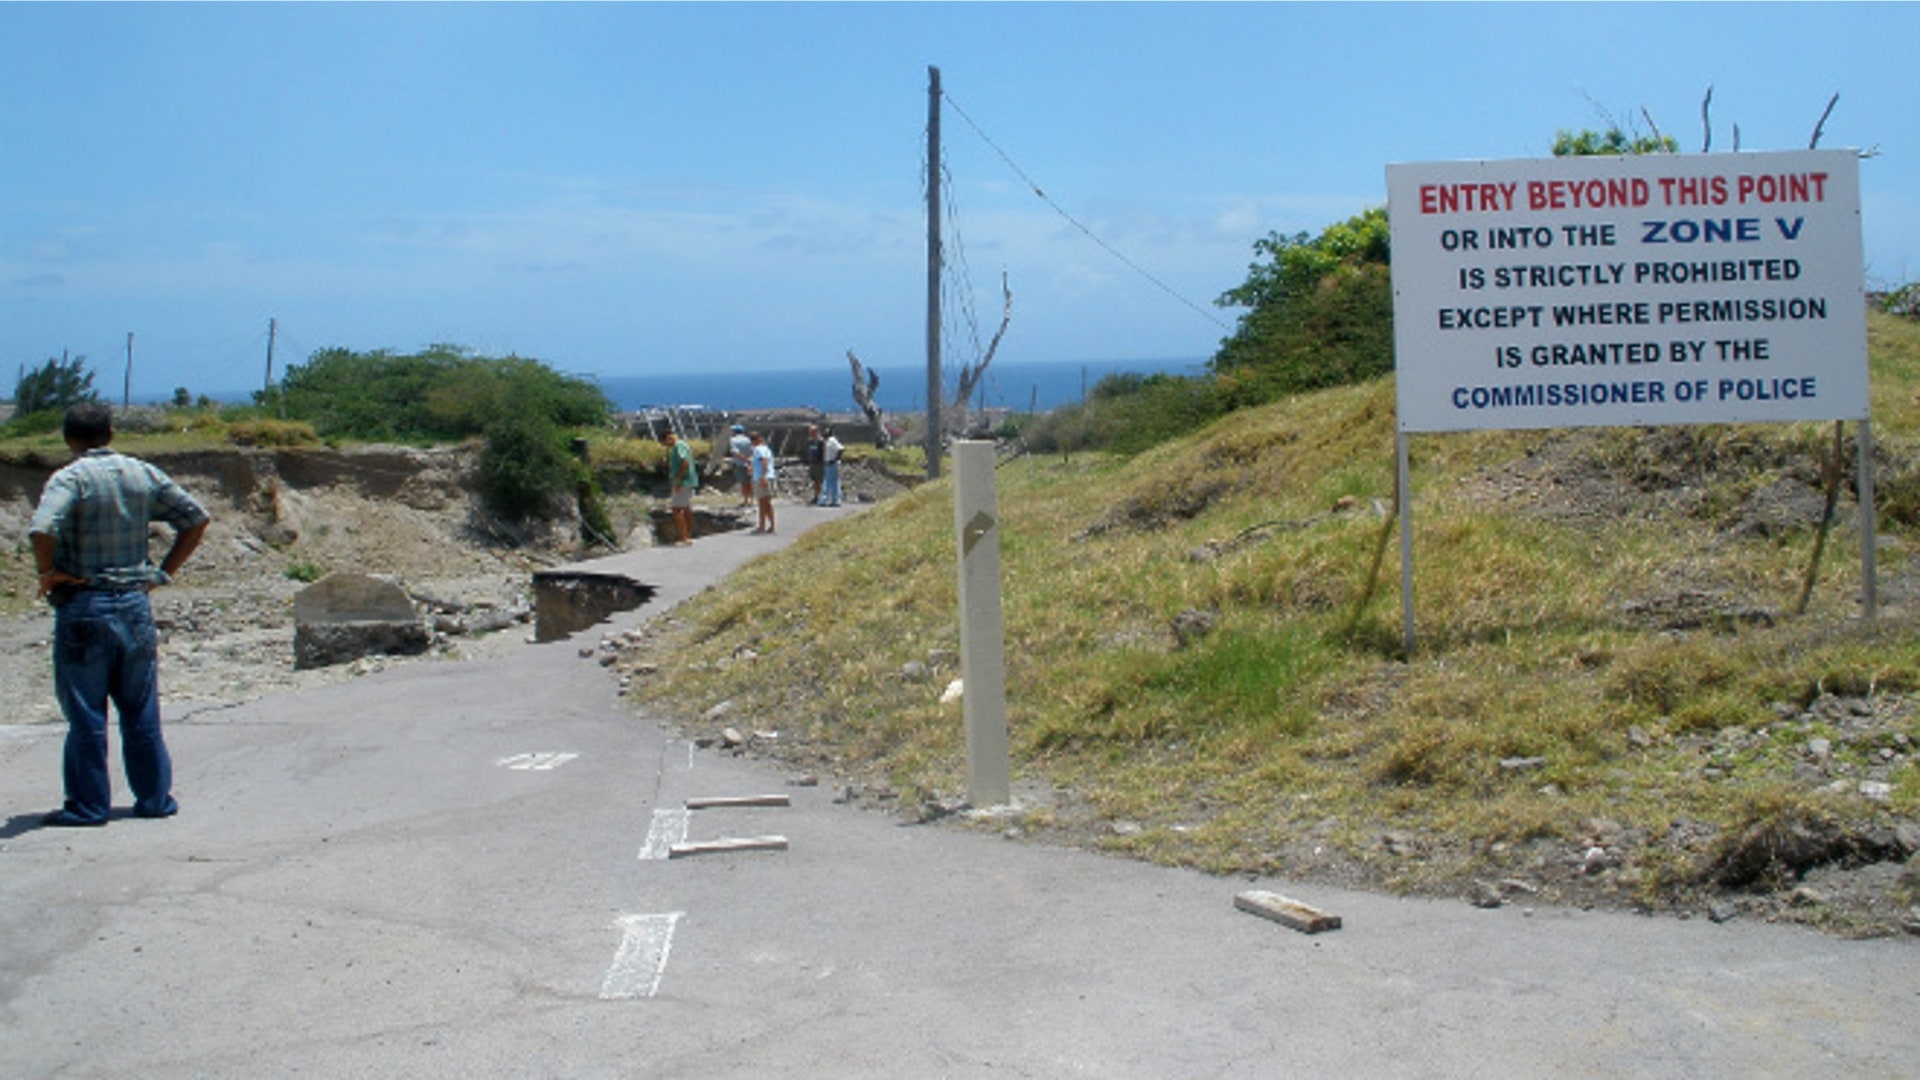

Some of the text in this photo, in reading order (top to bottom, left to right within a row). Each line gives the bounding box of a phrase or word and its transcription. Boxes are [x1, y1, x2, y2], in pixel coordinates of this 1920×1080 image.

[1420, 172, 1828, 214] ENTRY BEYOND THIS POINT
[1441, 216, 1805, 252] OR INTO THE ZONE V
[1459, 258, 1802, 290] IS STRICTLY PROHIBITED
[1439, 297, 1828, 330] EXCEPT WHERE PERMISSION
[1496, 338, 1770, 369] IS GRANTED BY THE
[1452, 376, 1817, 410] COMMISSIONER OF POLICE
